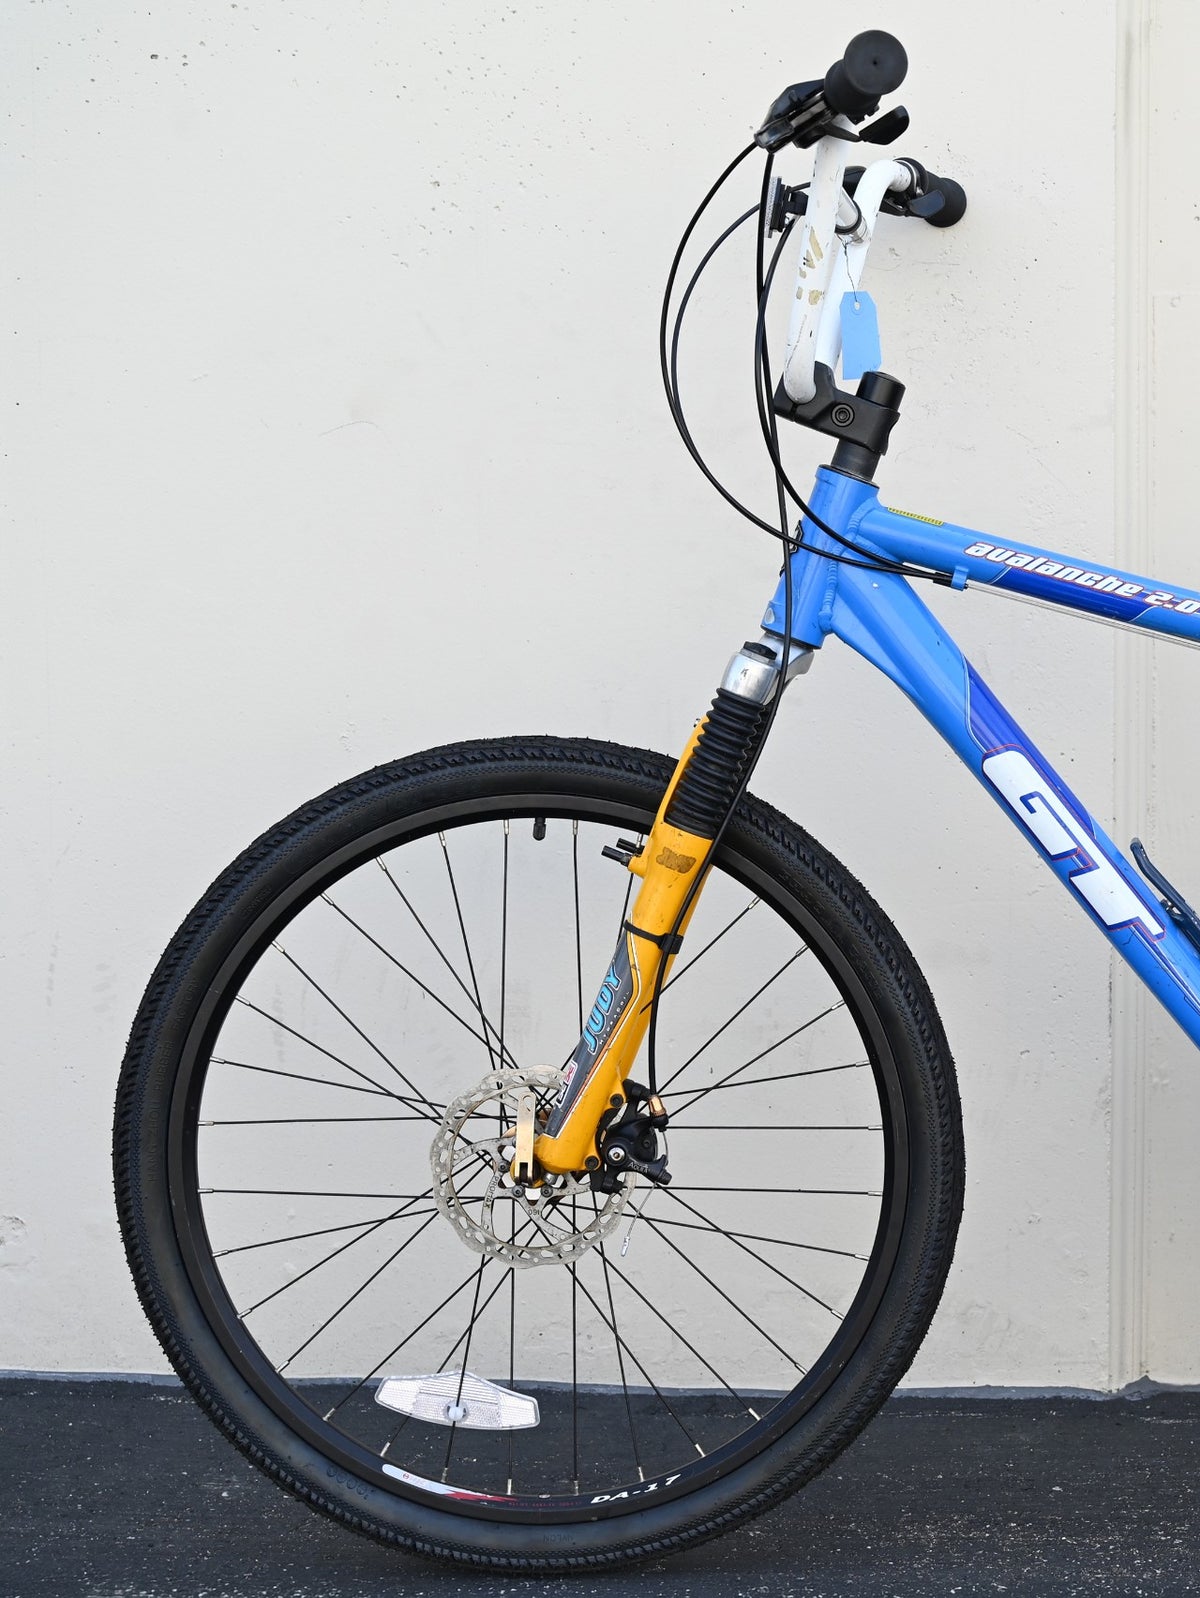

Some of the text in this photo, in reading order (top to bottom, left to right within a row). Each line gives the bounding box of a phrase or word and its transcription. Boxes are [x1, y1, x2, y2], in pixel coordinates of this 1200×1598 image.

[964, 541, 1144, 598] avalanche
[981, 746, 1166, 939] GT
[582, 962, 622, 1055] JUDY
